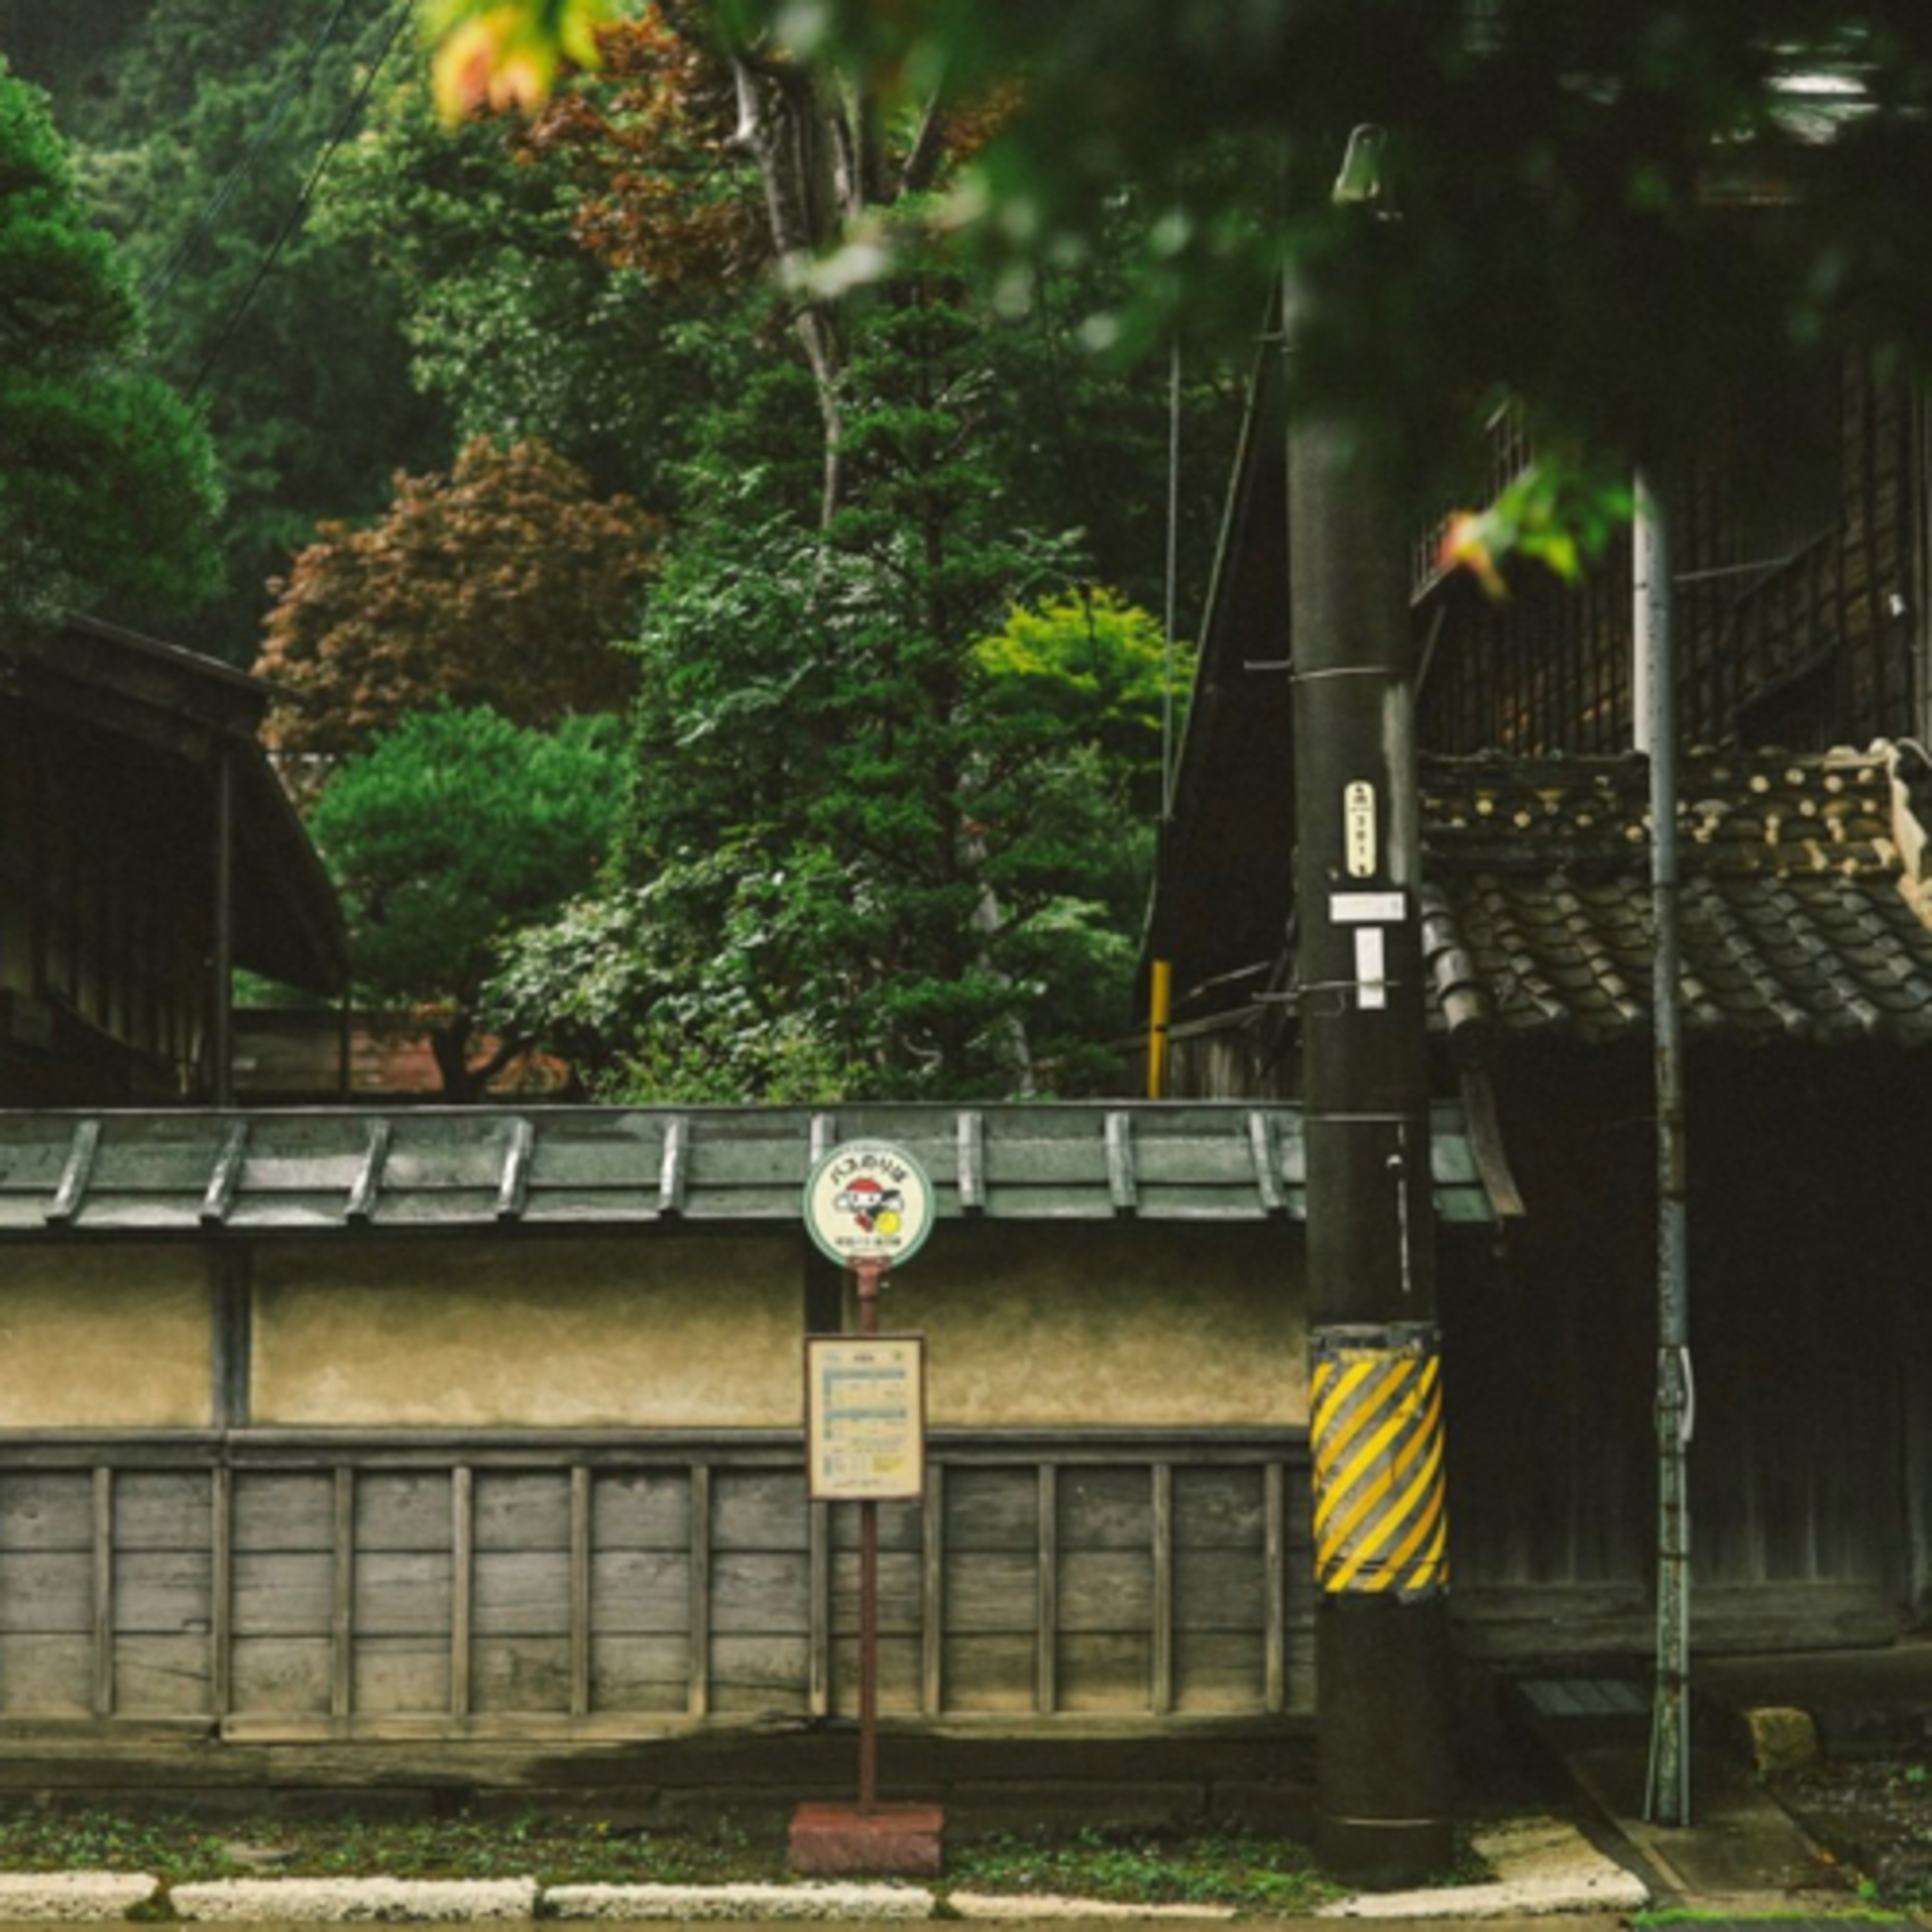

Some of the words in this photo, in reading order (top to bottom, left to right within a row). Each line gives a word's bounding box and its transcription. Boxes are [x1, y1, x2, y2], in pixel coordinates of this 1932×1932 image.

[829, 1154, 908, 1186] バスのりば
